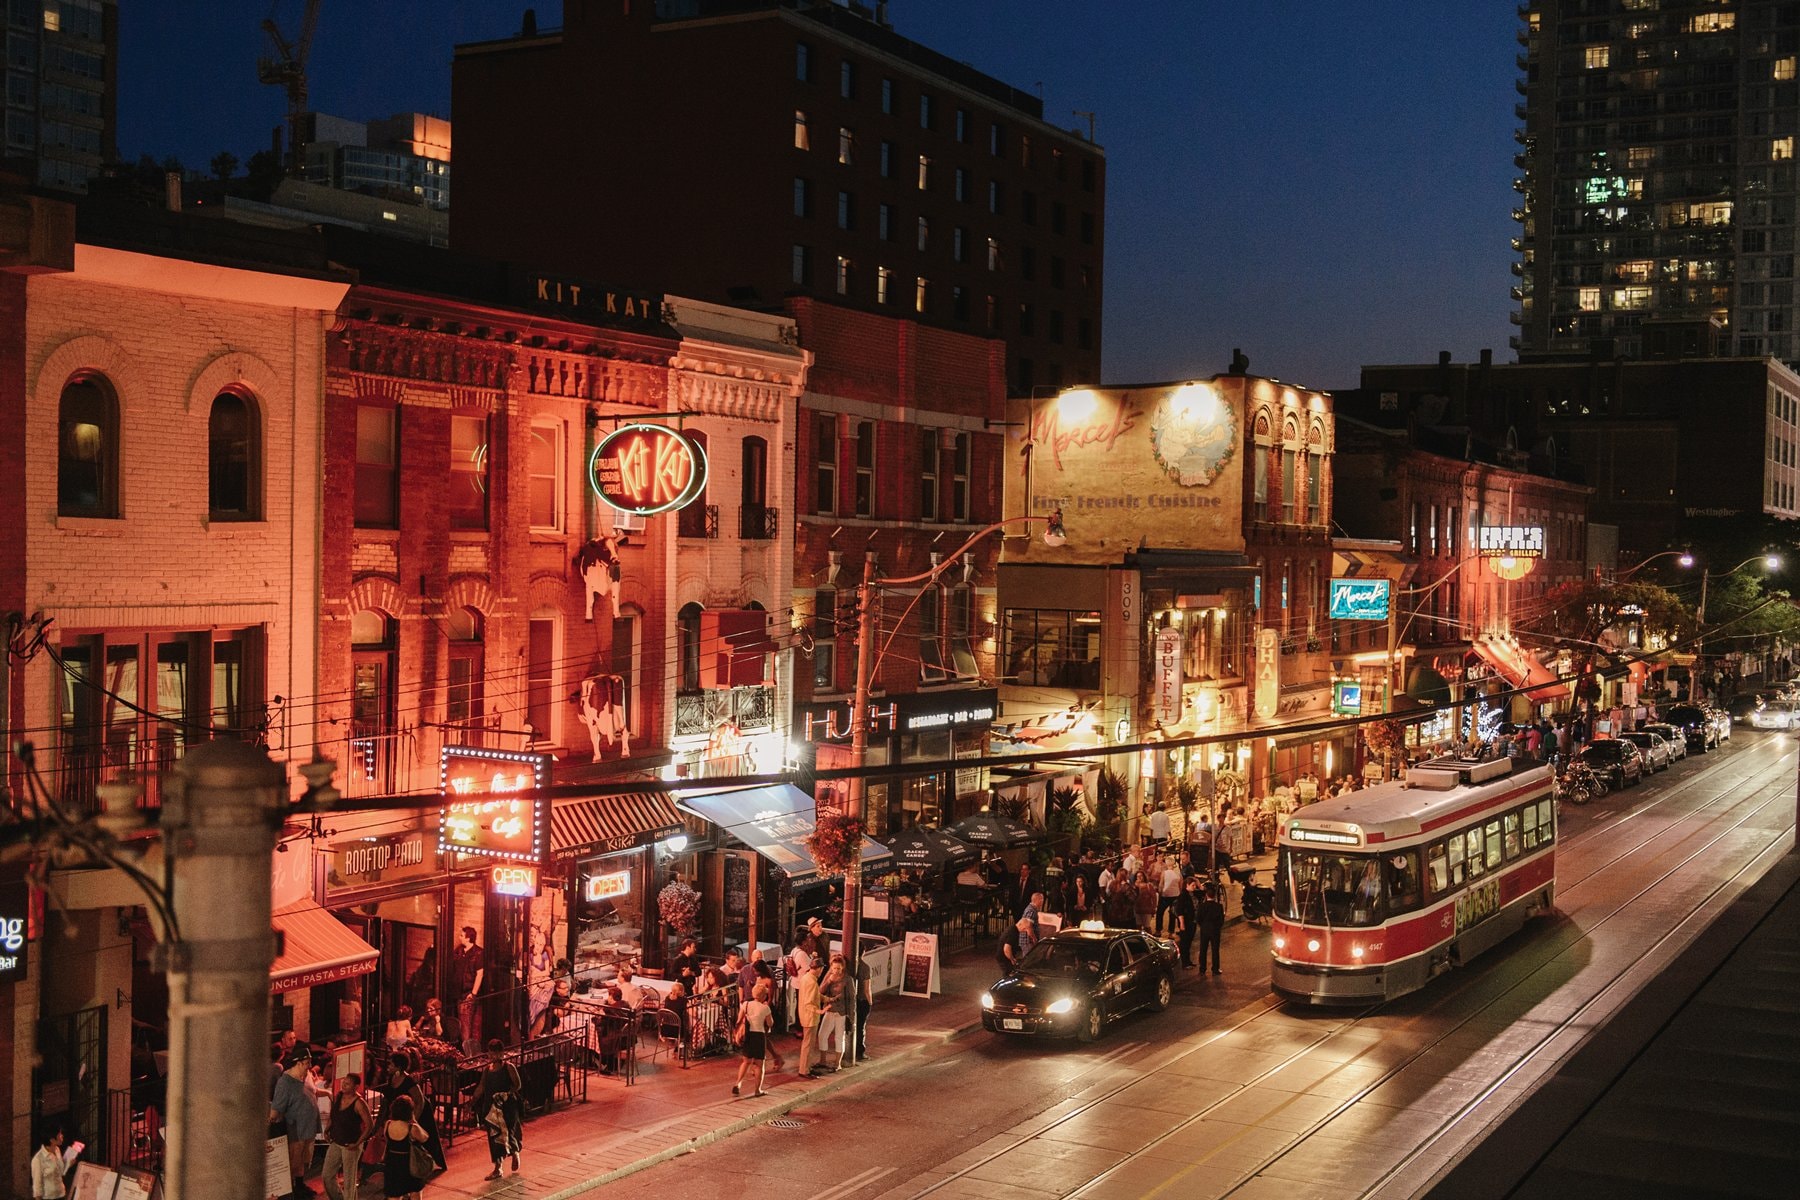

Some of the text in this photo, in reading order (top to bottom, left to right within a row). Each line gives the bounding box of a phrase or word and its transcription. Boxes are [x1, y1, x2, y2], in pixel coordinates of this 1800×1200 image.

[538, 279, 650, 319] KIT KAT
[1032, 492, 1222, 509] Fin French Cuisine
[1684, 507, 1744, 519] Westingho
[1160, 643, 1175, 721] BUFFET
[805, 702, 898, 742] HUH
[345, 844, 391, 876] ROOFTOP
[394, 839, 424, 868] PATIO
[493, 867, 532, 886] OPEN
[592, 875, 626, 897] OPEN
[302, 969, 335, 985] PASTA
[339, 960, 372, 977] STEAK
